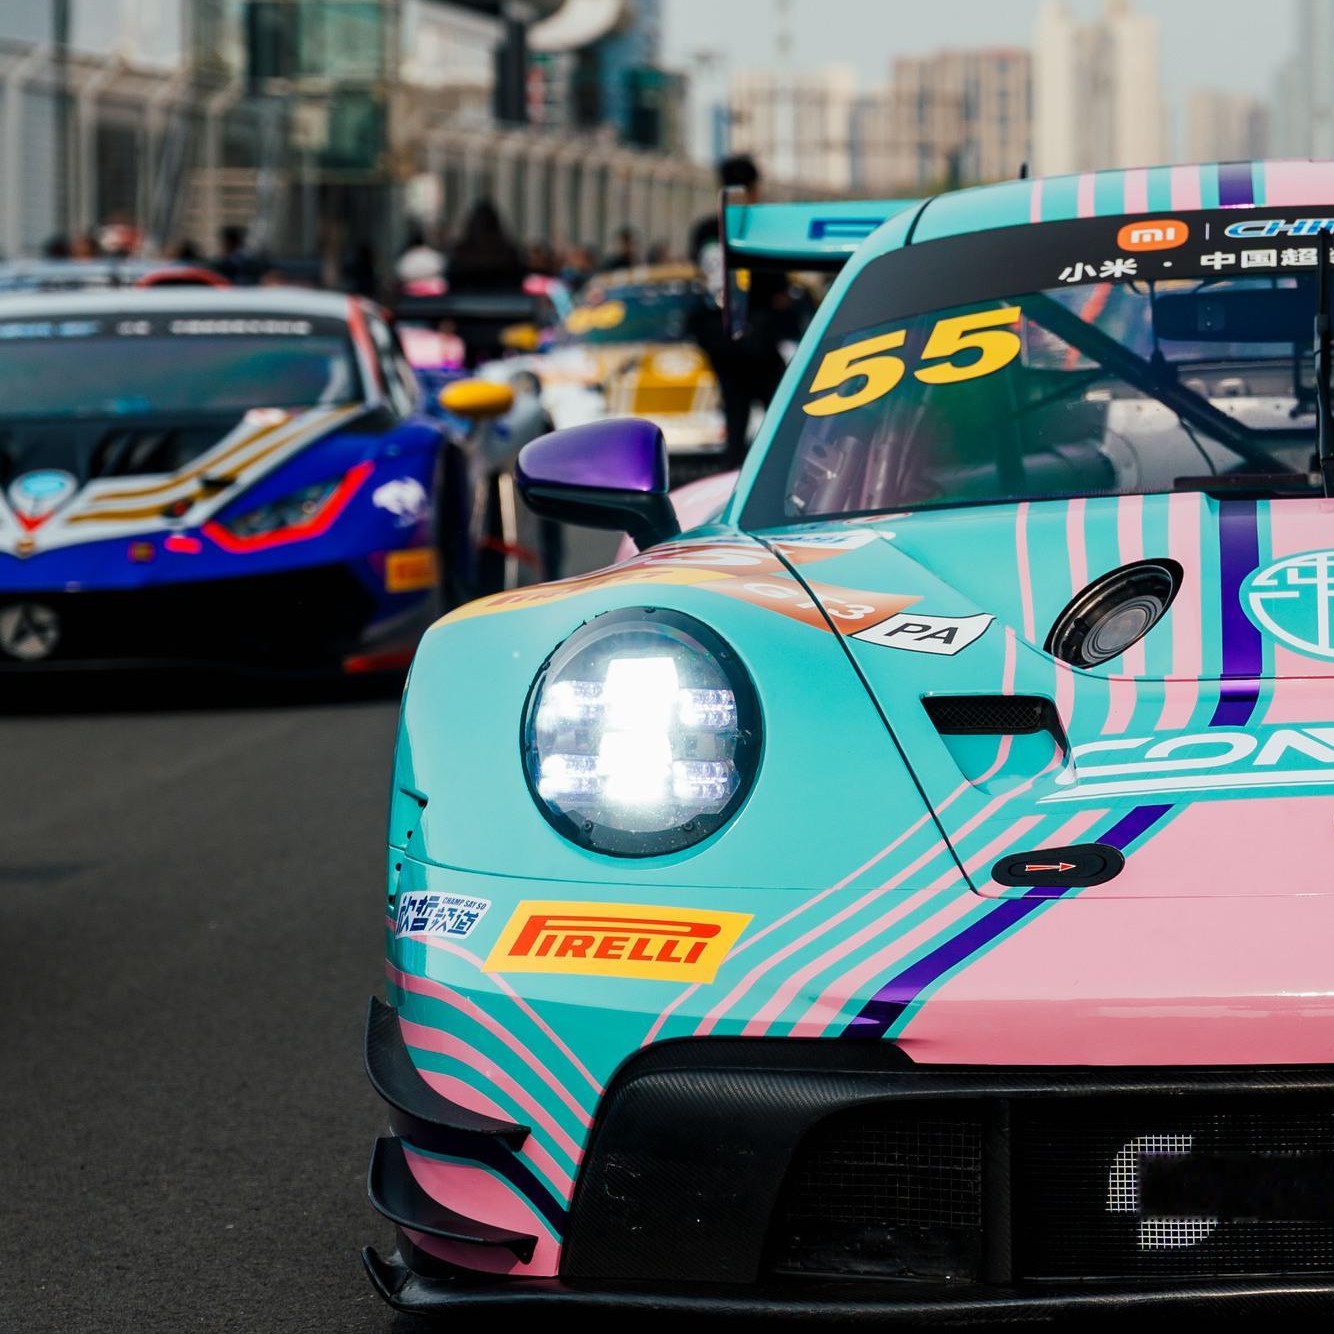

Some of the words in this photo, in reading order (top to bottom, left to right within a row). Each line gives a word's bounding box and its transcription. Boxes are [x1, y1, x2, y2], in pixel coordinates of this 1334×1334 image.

[802, 306, 1021, 416] 55
[743, 582, 876, 621] GT3
[884, 622, 959, 645] PA
[507, 915, 722, 964] PIRELLI
